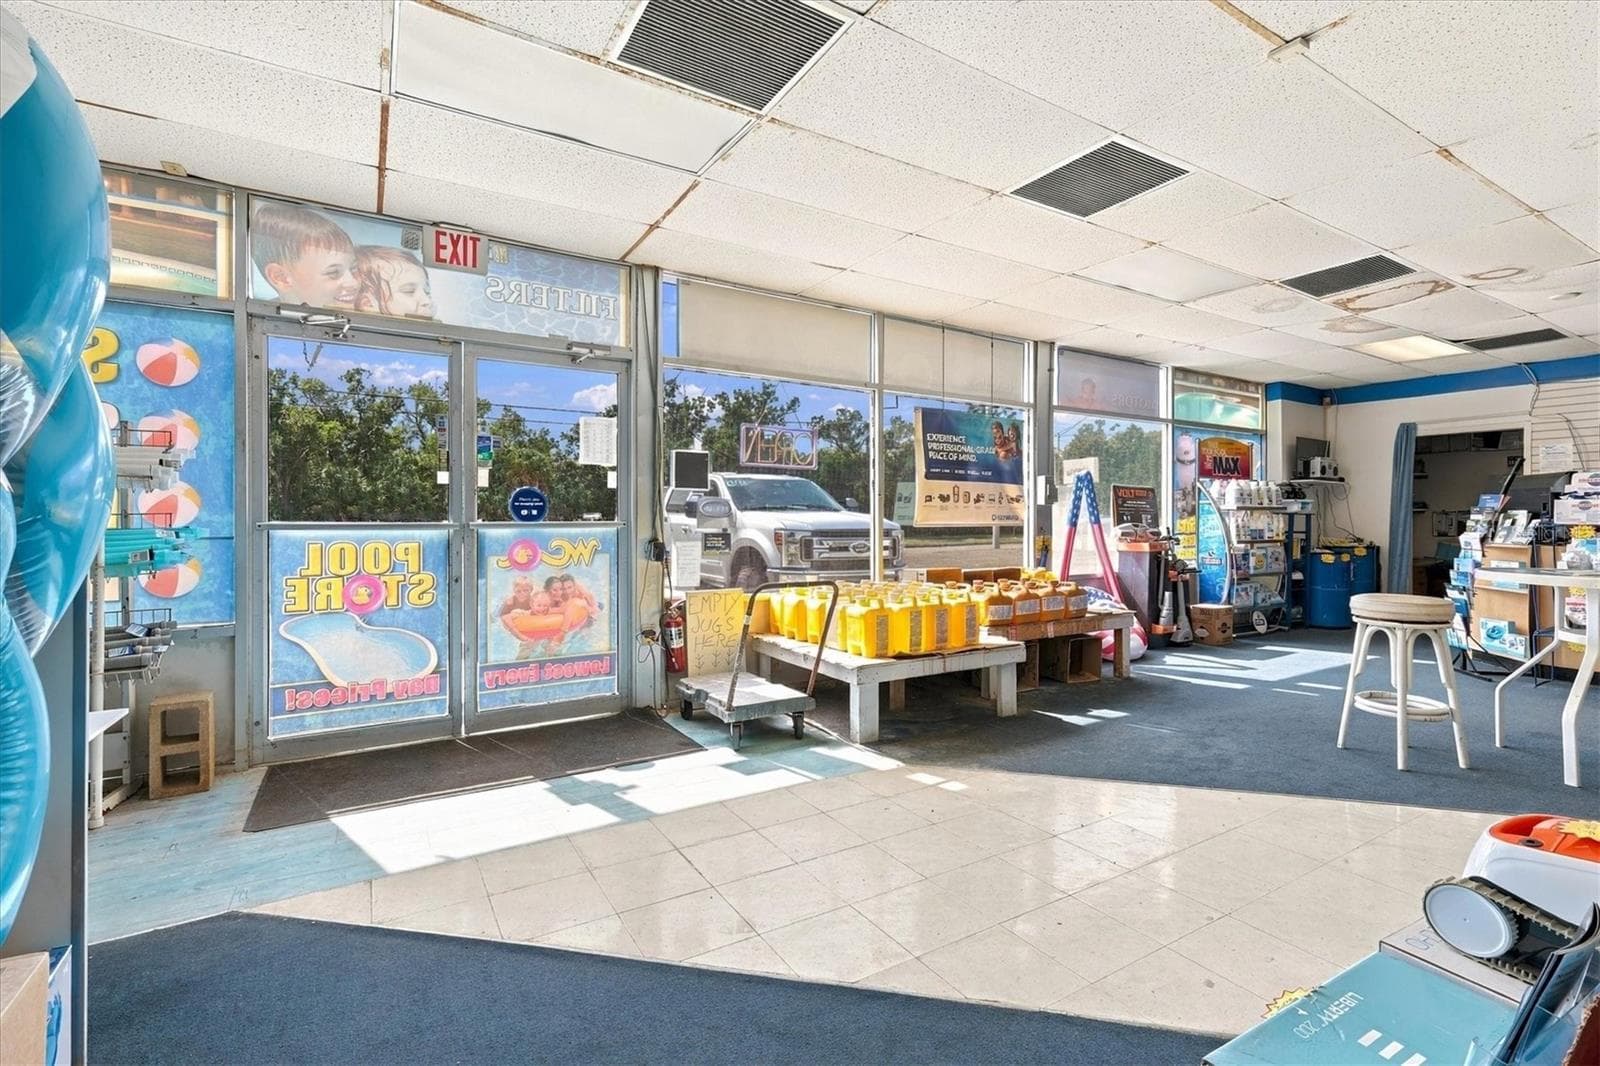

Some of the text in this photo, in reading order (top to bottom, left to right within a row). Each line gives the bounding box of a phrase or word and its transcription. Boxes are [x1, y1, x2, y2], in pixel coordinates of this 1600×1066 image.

[434, 229, 481, 268] EXIT
[926, 432, 966, 444] EXPERIENCE
[948, 452, 958, 461] OF
[1213, 455, 1242, 476] MAX
[687, 592, 743, 616] EMPTY
[691, 615, 735, 634] JUGS
[693, 633, 739, 653] HERE
[1291, 991, 1364, 1040] LIBERTY 200
